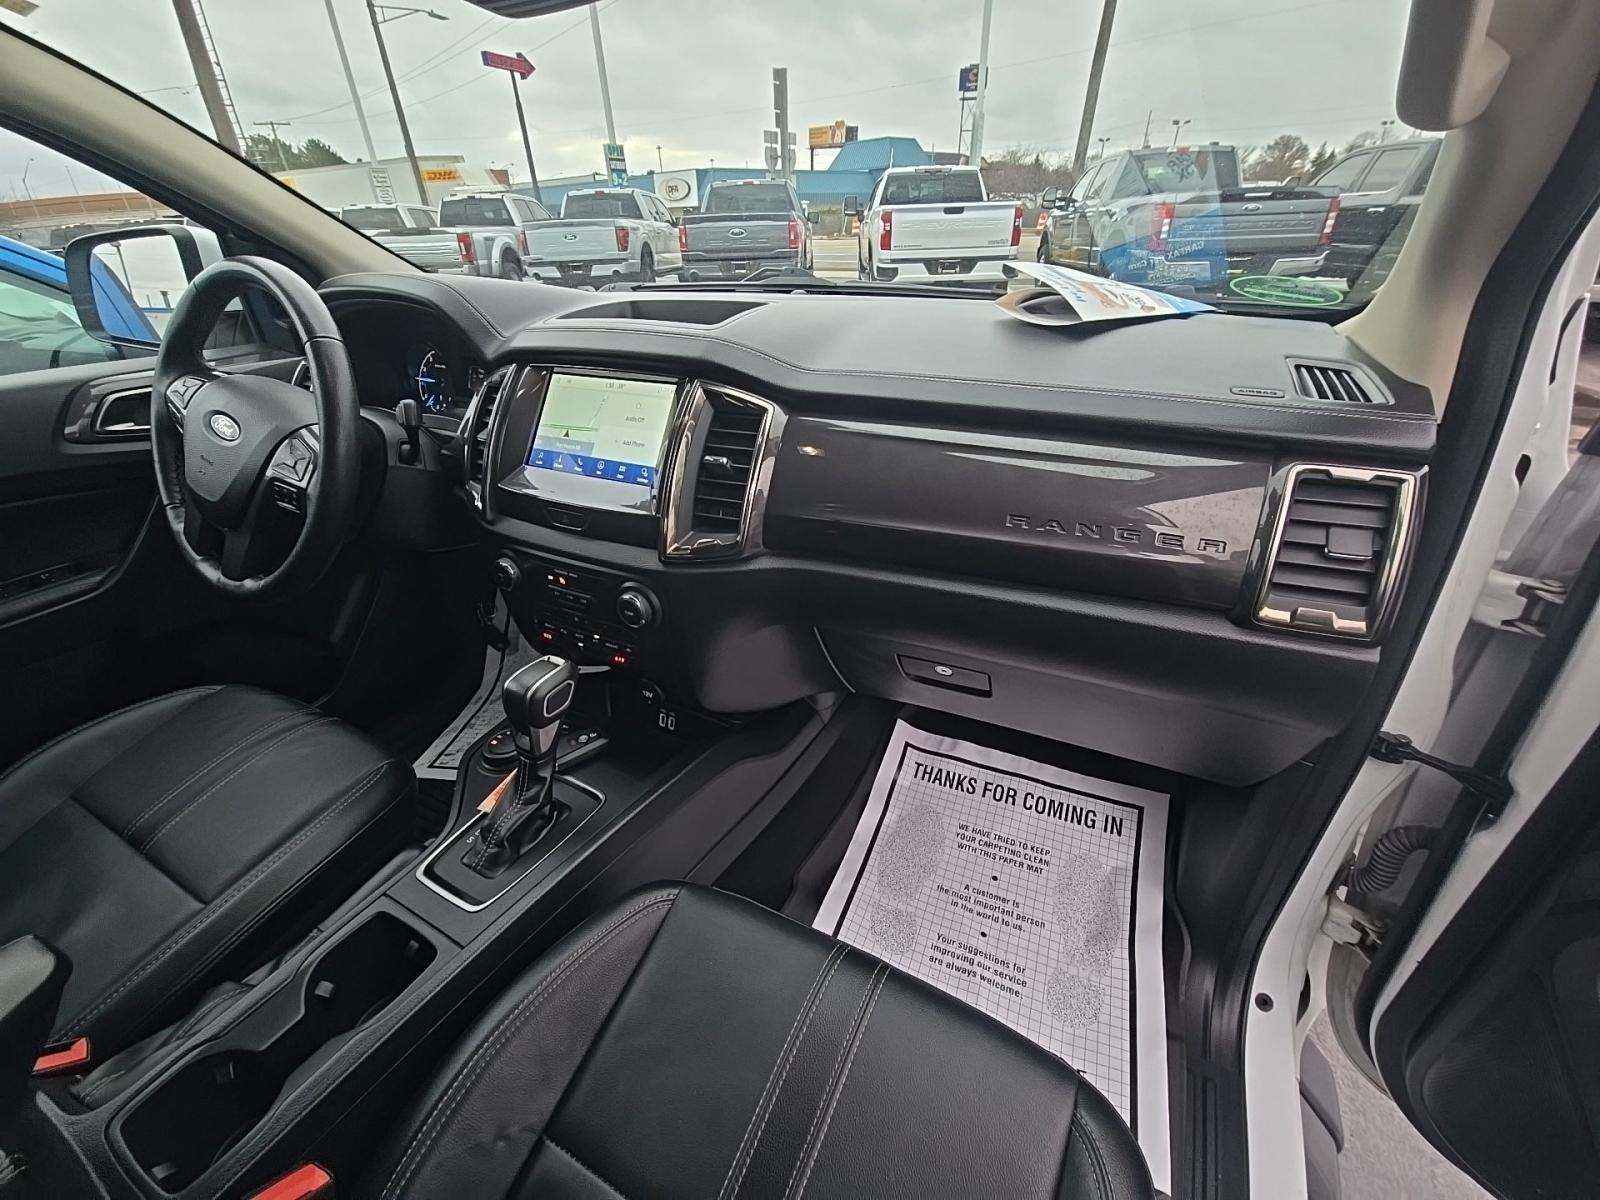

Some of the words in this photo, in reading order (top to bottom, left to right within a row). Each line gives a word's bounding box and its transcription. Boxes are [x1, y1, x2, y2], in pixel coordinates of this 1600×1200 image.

[1005, 513, 1228, 554] RANGER
[913, 761, 978, 795] THANKS
[981, 780, 1018, 806] FOR
[1022, 791, 1097, 830] COMING
[1103, 813, 1124, 838] IN
[956, 832, 976, 844] YOUR
[978, 838, 1021, 858] CARPETING
[1023, 853, 1050, 867] CLEAN
[957, 841, 977, 854] WITH
[979, 848, 997, 861] THIS
[998, 855, 1024, 869] PAPER
[1026, 863, 1044, 875] MAT
[958, 822, 970, 832] WE
[971, 827, 992, 839] HAVE
[993, 833, 1016, 846] TRIED
[1018, 841, 1028, 850] TO
[1030, 845, 1051, 856] KEEP
[937, 884, 950, 895] the
[951, 890, 972, 902] most
[973, 896, 1014, 918] important
[1015, 912, 1046, 929] person
[950, 898, 959, 907] in
[960, 902, 974, 914] the
[975, 910, 1000, 923] world
[1001, 918, 1010, 927] to
[1012, 922, 1026, 932] us.
[963, 883, 970, 892] A
[971, 887, 1010, 905] customer
[1012, 899, 1020, 909] is
[930, 943, 975, 967] improving
[977, 960, 992, 972] our
[993, 968, 1027, 988] service
[936, 932, 956, 946] Your
[958, 941, 1011, 969] suggestions
[1012, 962, 1026, 974] for
[928, 955, 943, 965] are
[945, 961, 977, 978] always
[979, 973, 1023, 999] welcome.
